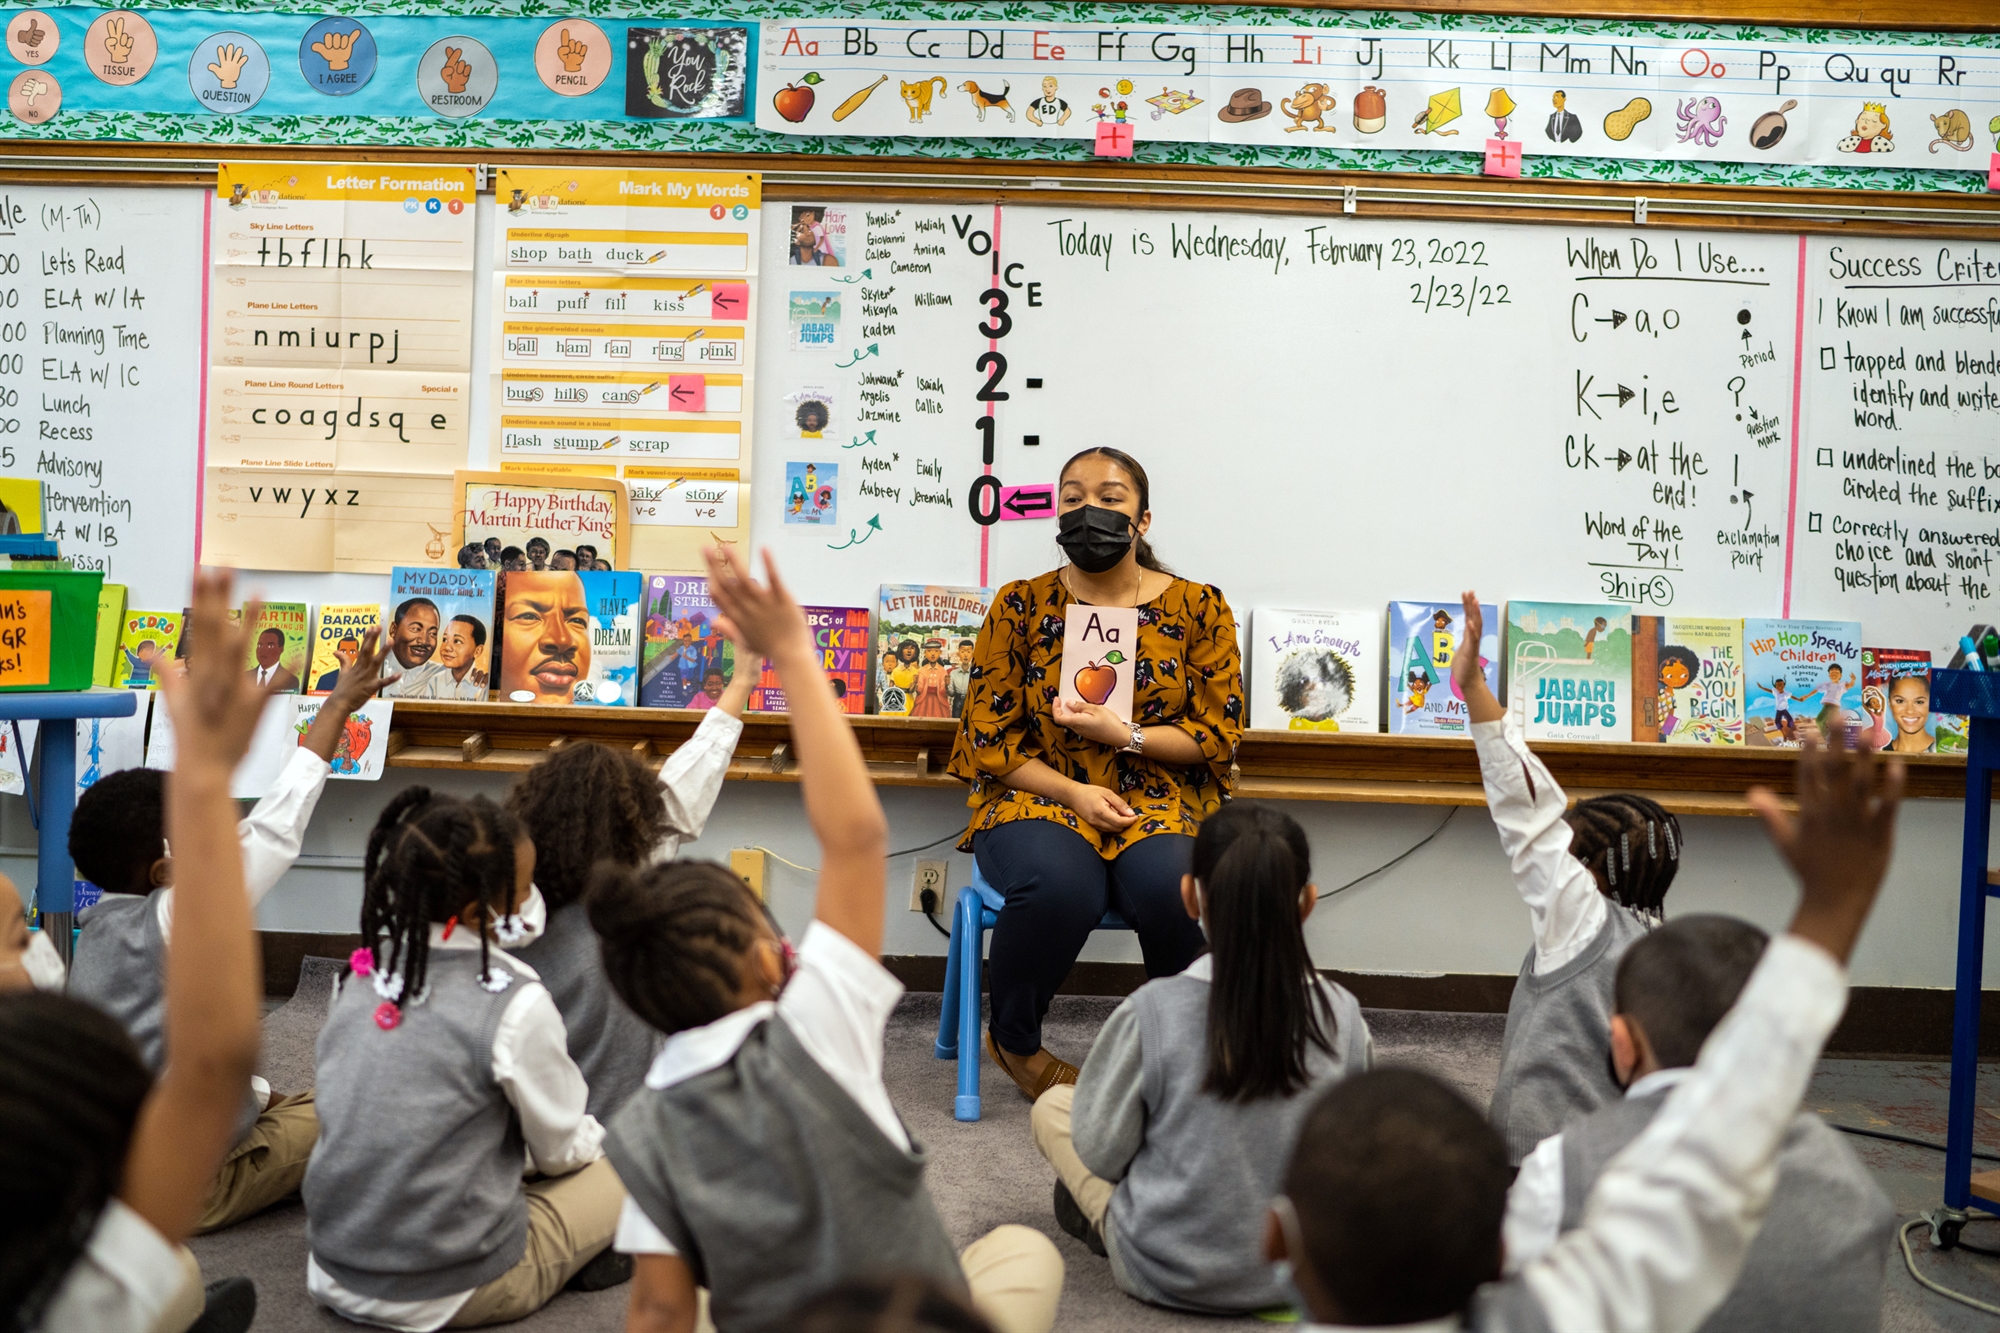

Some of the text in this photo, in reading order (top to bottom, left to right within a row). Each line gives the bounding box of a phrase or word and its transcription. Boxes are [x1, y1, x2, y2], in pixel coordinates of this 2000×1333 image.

[25, 50, 39, 58] YES
[666, 45, 705, 72] You
[781, 28, 1966, 95] Aa Bb Cc Dd Ee Ff Gg Hh Kk Mm Nn Oo Pp Rr
[102, 65, 136, 77] TISSUE
[327, 73, 357, 84] AGREE
[555, 75, 588, 86] PENCIL
[668, 70, 706, 104] Rock
[202, 91, 251, 103] QUESTION
[431, 95, 482, 107] RESTROOM
[28, 110, 39, 118] NO
[1042, 104, 1056, 114] ED
[326, 176, 464, 191] Letter Formation
[619, 182, 749, 199] Mark My Words
[825, 211, 846, 223] Hair
[915, 218, 945, 233] Maliah
[250, 223, 265, 231] Sky
[867, 232, 905, 245] Giovanni
[1047, 219, 1383, 275] Today is Wednesday, February
[511, 247, 643, 262] shop bath duck
[866, 249, 891, 260] Caleb
[913, 243, 945, 255] Amina
[1567, 237, 1657, 277] When Do
[42, 245, 125, 275] Let's Read
[891, 261, 931, 274] Cameron
[1830, 246, 1921, 280] Success
[45, 288, 82, 311] ELA
[509, 296, 685, 312] ball puff fill kiss
[915, 293, 952, 306] William
[1411, 275, 1511, 316] 2/23/22
[863, 305, 898, 318] Mikayla
[978, 288, 1012, 339] 3
[1901, 305, 1926, 331] am
[800, 323, 834, 333] JABARI
[863, 323, 896, 338] Kaden
[43, 321, 149, 355] Planning Time
[800, 334, 834, 343] JUMPS
[1844, 340, 1946, 379] tapped and
[42, 358, 81, 383] ELA
[976, 352, 1010, 401] 2
[245, 380, 266, 388] Plane
[288, 381, 313, 389] Round
[316, 382, 344, 390] Letters
[421, 385, 450, 394] Special
[917, 378, 944, 395] Isaiah
[860, 390, 890, 408] Argelis
[1853, 379, 2000, 411] identify and write
[42, 393, 90, 417] Lunch
[916, 399, 943, 414] Callie
[858, 408, 901, 422] Jazmine
[39, 421, 93, 440] Recess
[505, 434, 669, 452] flash stump scrap
[975, 416, 995, 465] 1
[37, 450, 102, 488] Advisory
[241, 459, 263, 467] Plane
[1638, 440, 1708, 480] at the
[1843, 446, 1976, 478] underlined the
[916, 459, 942, 482] Emily
[860, 480, 900, 503] Aubrey
[910, 488, 953, 508] Jeremiah
[1909, 482, 1938, 506] the
[483, 491, 613, 515] Happy Birthday,
[523, 513, 614, 539] Luther King
[1585, 511, 1683, 542] Word of the
[1717, 524, 1779, 547] exclamation
[1836, 539, 1993, 577] choice and short
[404, 572, 477, 587] MY DADDY,
[1835, 563, 1991, 600] question about the
[409, 586, 431, 595] Martin
[600, 598, 628, 616] HAVE
[887, 595, 988, 616] LET THE CHILDREN
[129, 616, 175, 634] PEDRO
[323, 615, 376, 625] BARACK
[913, 610, 958, 624] MARCH
[1082, 613, 1119, 643] Aa
[594, 629, 631, 646] DREAM
[1284, 630, 1361, 657] Am Enough
[1750, 631, 1858, 659] Hip Hop Speaks
[1711, 646, 1733, 659] THE
[1780, 649, 1836, 663] Children
[1703, 660, 1734, 679] DAY
[1535, 678, 1615, 702] JABARI
[1700, 680, 1736, 698] YOU
[1424, 701, 1468, 714] AND ME
[1534, 701, 1616, 727] JUMPS
[1547, 731, 1600, 740] Gaia Cornwall
